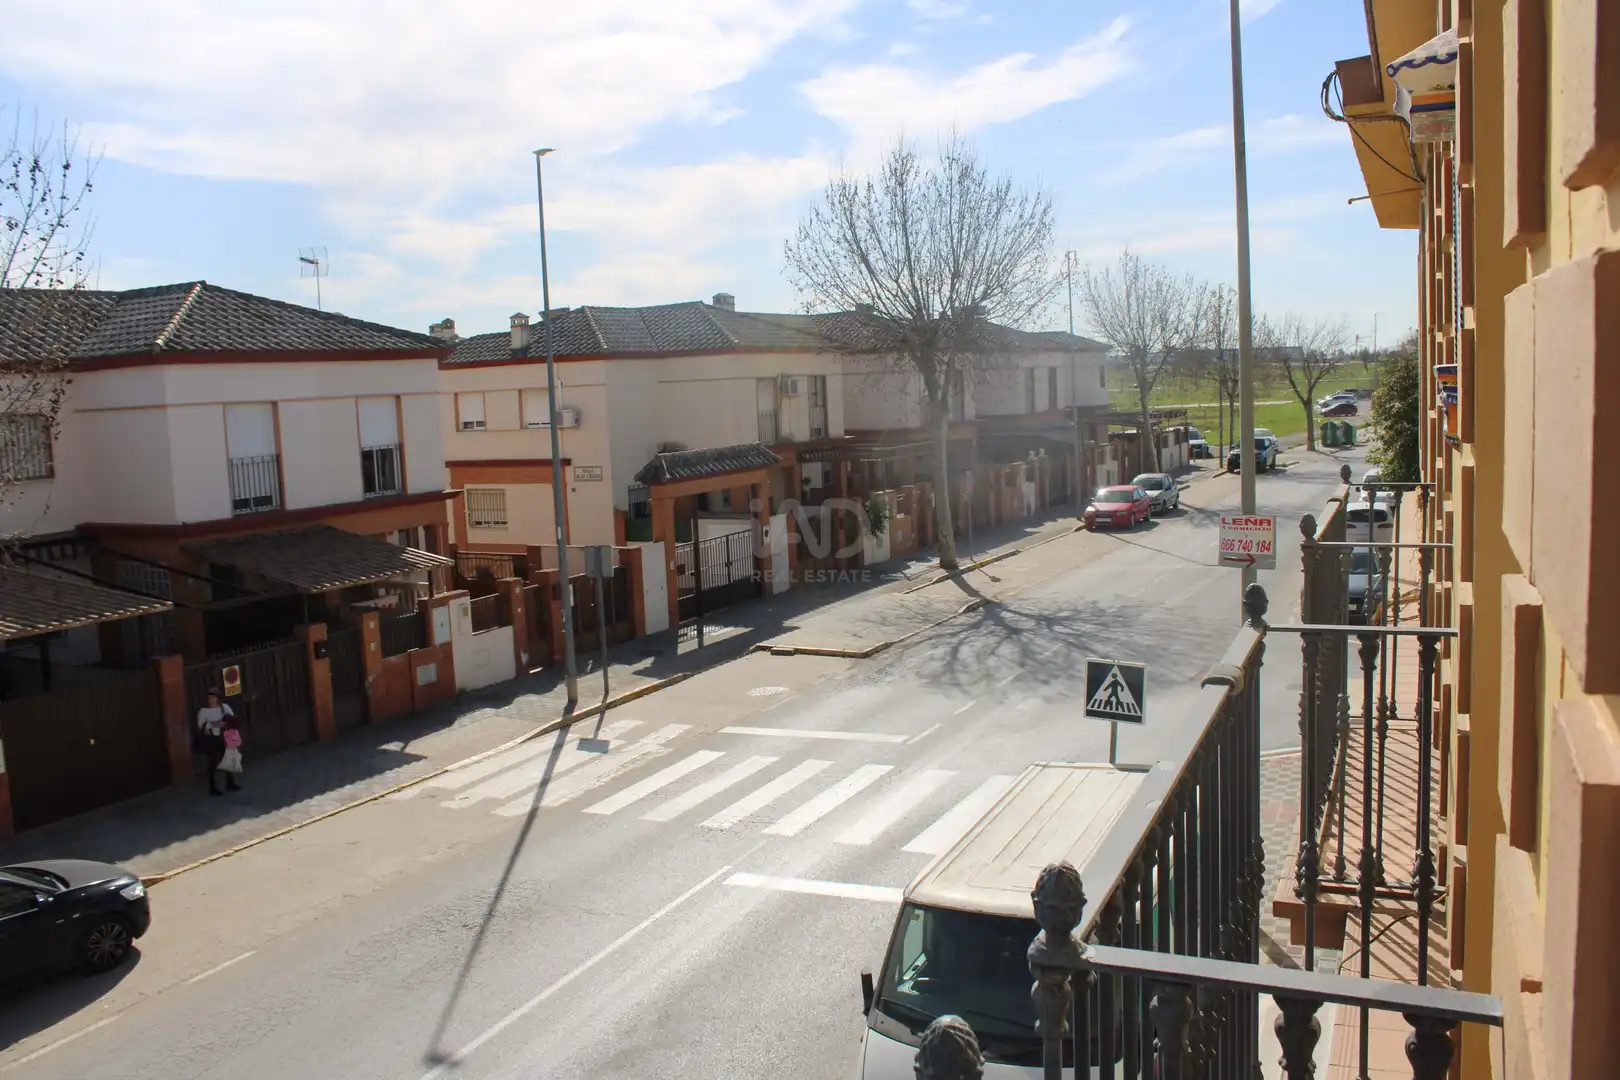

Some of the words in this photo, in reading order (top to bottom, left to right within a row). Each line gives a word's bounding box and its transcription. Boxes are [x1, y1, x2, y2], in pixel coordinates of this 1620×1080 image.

[1221, 538, 1235, 552] 666
[1237, 539, 1253, 553] 740
[1256, 539, 1272, 553] 184
